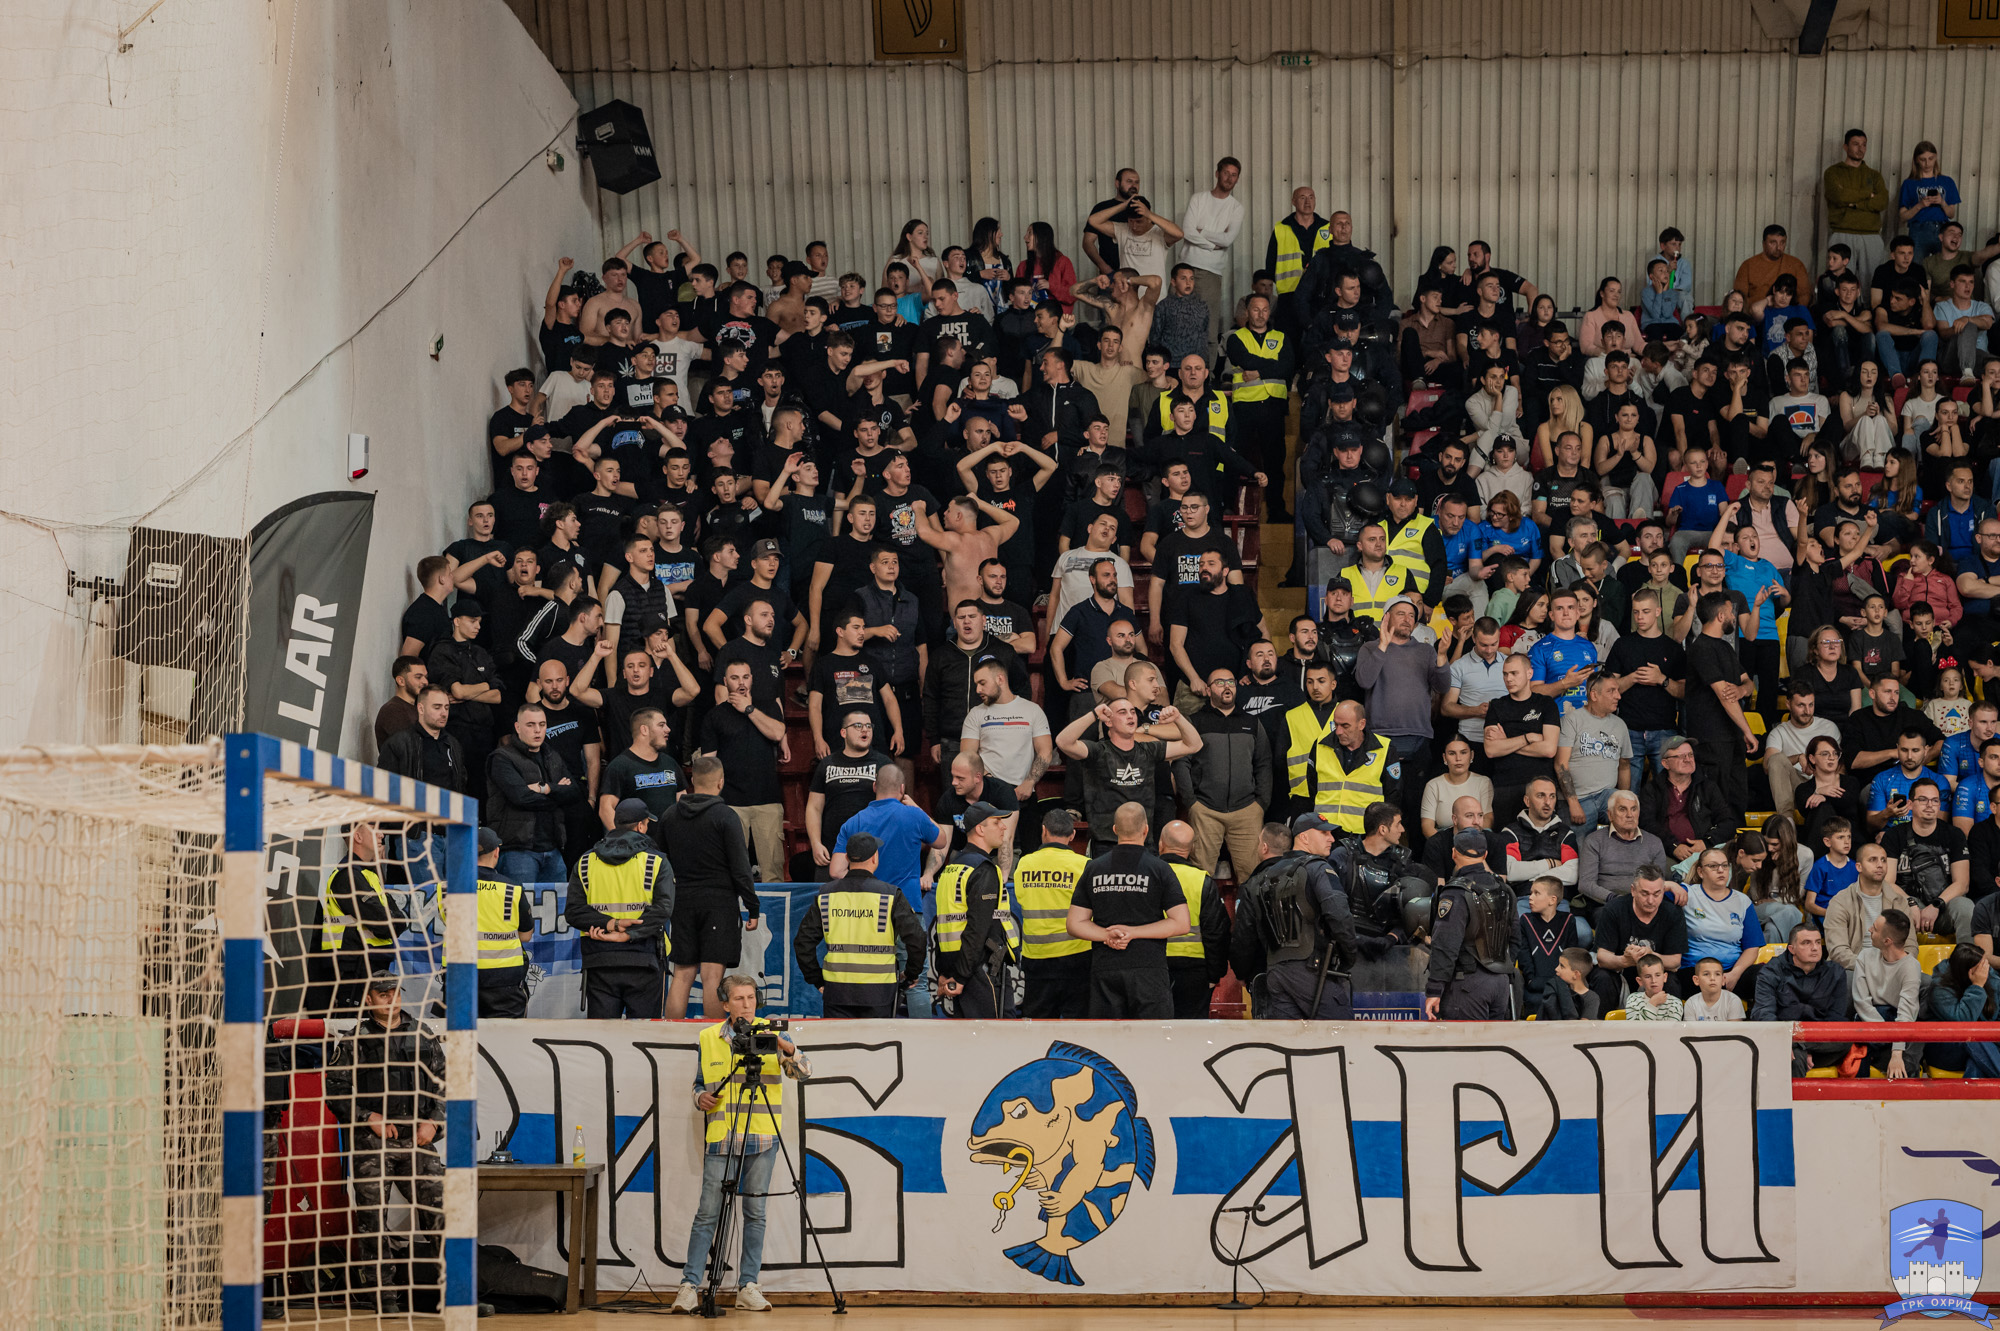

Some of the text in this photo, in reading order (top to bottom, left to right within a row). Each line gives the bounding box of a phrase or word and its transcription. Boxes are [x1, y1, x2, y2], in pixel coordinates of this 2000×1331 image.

[1281, 56, 1300, 66] EXIT
[940, 322, 968, 334] JUST
[656, 356, 674, 364] HU
[656, 364, 674, 373] GO
[634, 393, 652, 401] ohri
[1178, 556, 1201, 564] СЕК
[1178, 573, 1200, 582] ЗАБА
[986, 616, 1012, 625] ЕКС
[825, 764, 876, 780] LONSDALE
[1022, 871, 1074, 883] ПИТОН
[1092, 874, 1149, 887] ПИТОН
[831, 908, 874, 918] ПОЛИЦИЈА
[483, 933, 516, 941] ПОЛИЦИЈА
